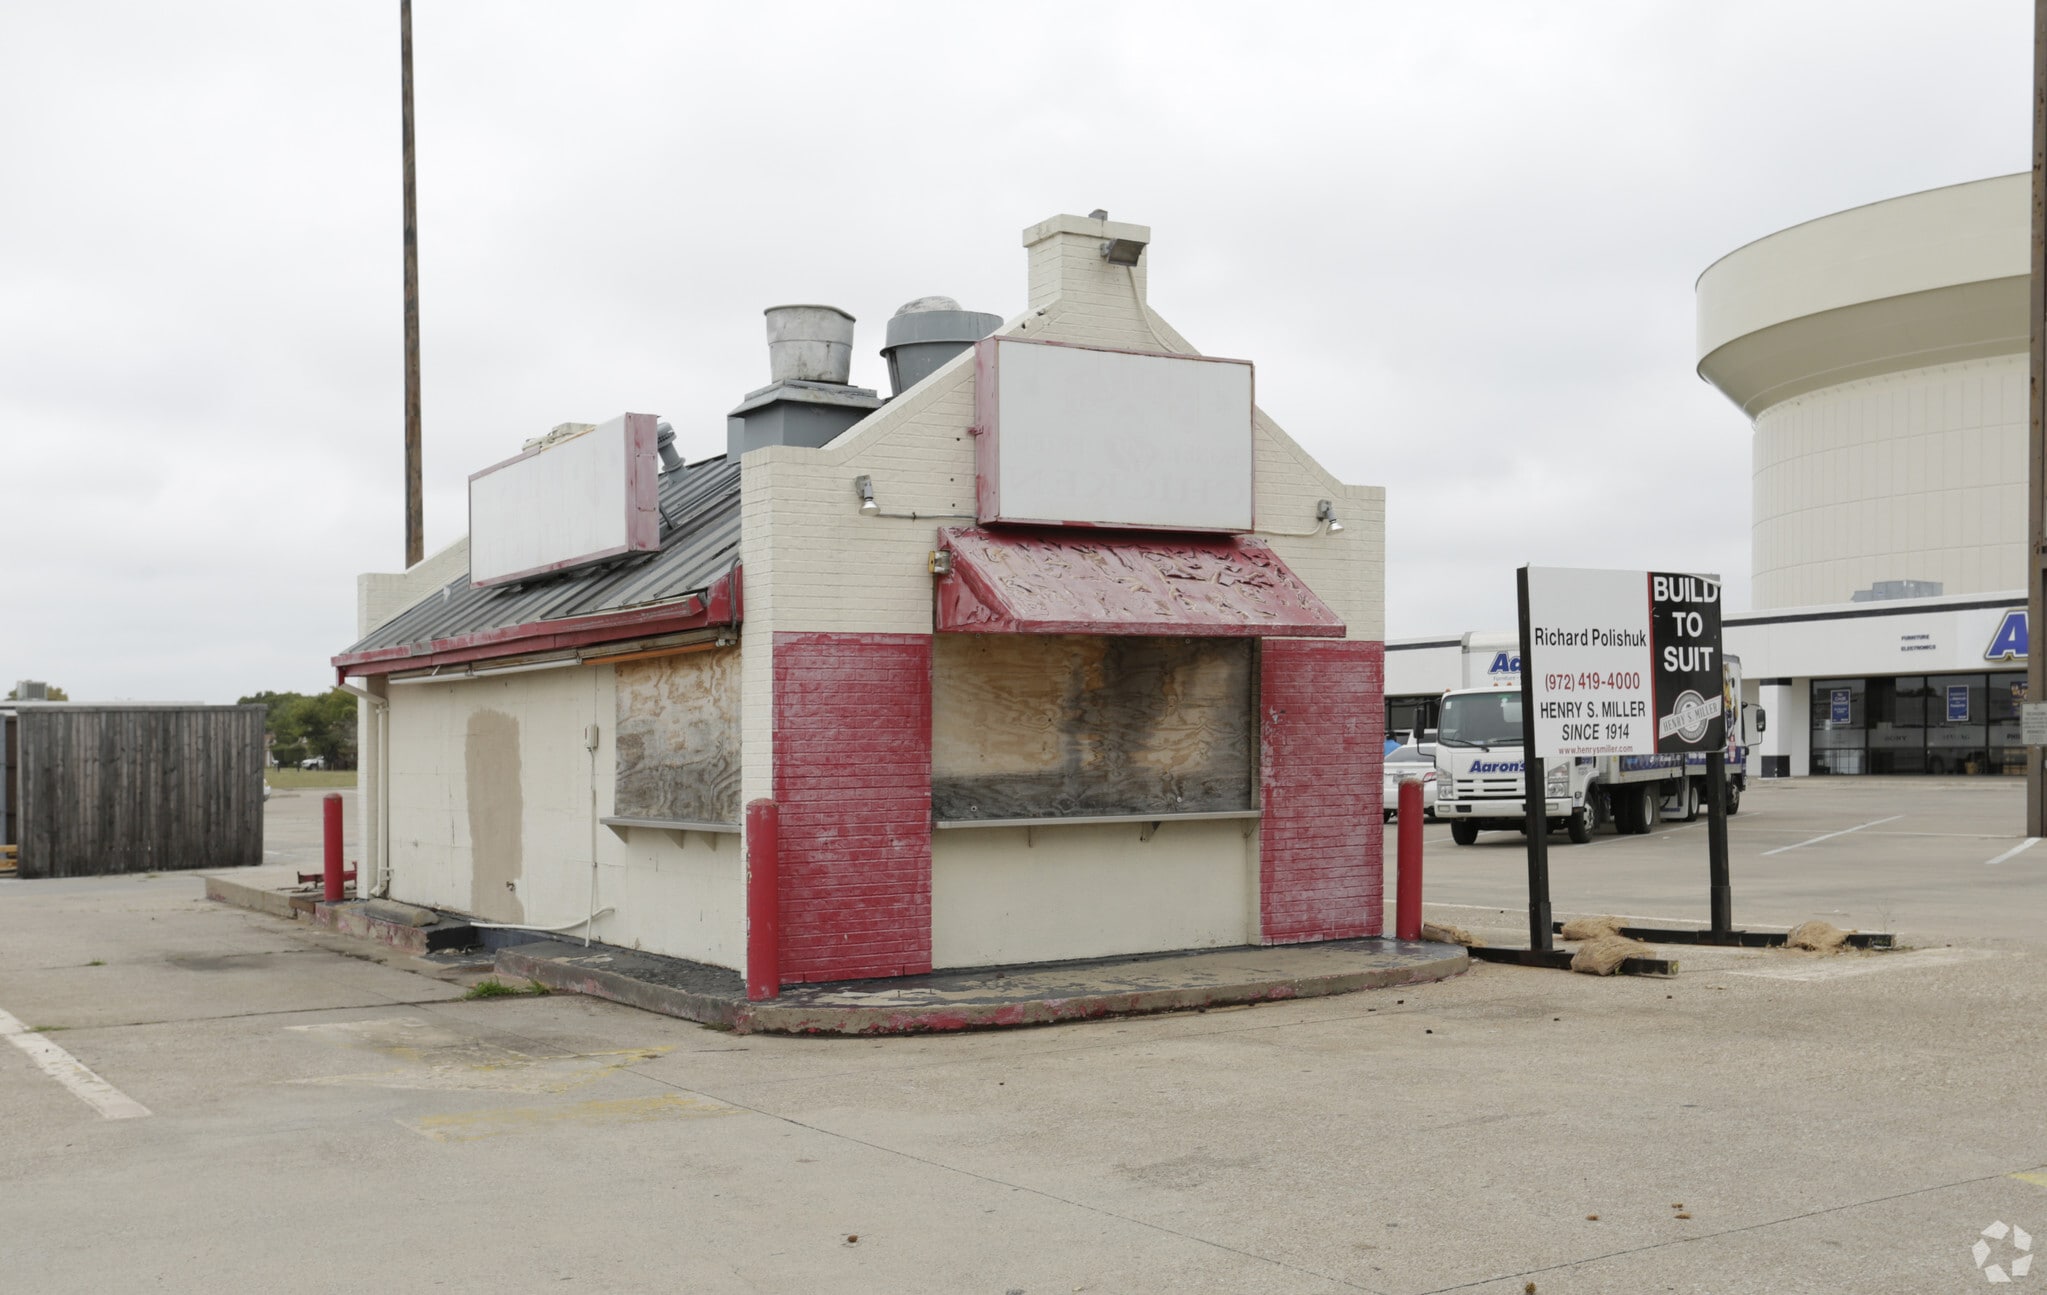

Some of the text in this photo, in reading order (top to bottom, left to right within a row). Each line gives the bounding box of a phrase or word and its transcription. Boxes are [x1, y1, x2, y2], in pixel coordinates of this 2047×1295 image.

[1654, 576, 1718, 603] BUILD
[1672, 611, 1703, 637] TO
[1535, 627, 1647, 647] Richard Polishuk
[1663, 646, 1714, 673] SUIT
[1545, 671, 1640, 692] (972) 419-4000
[1540, 701, 1646, 719] HENRY S. MILLER
[1663, 714, 1686, 732] HENRY
[1694, 702, 1718, 719] MILLER
[1562, 724, 1630, 741] SINCE 1914
[1558, 744, 1633, 756] www.henrysmiller.com
